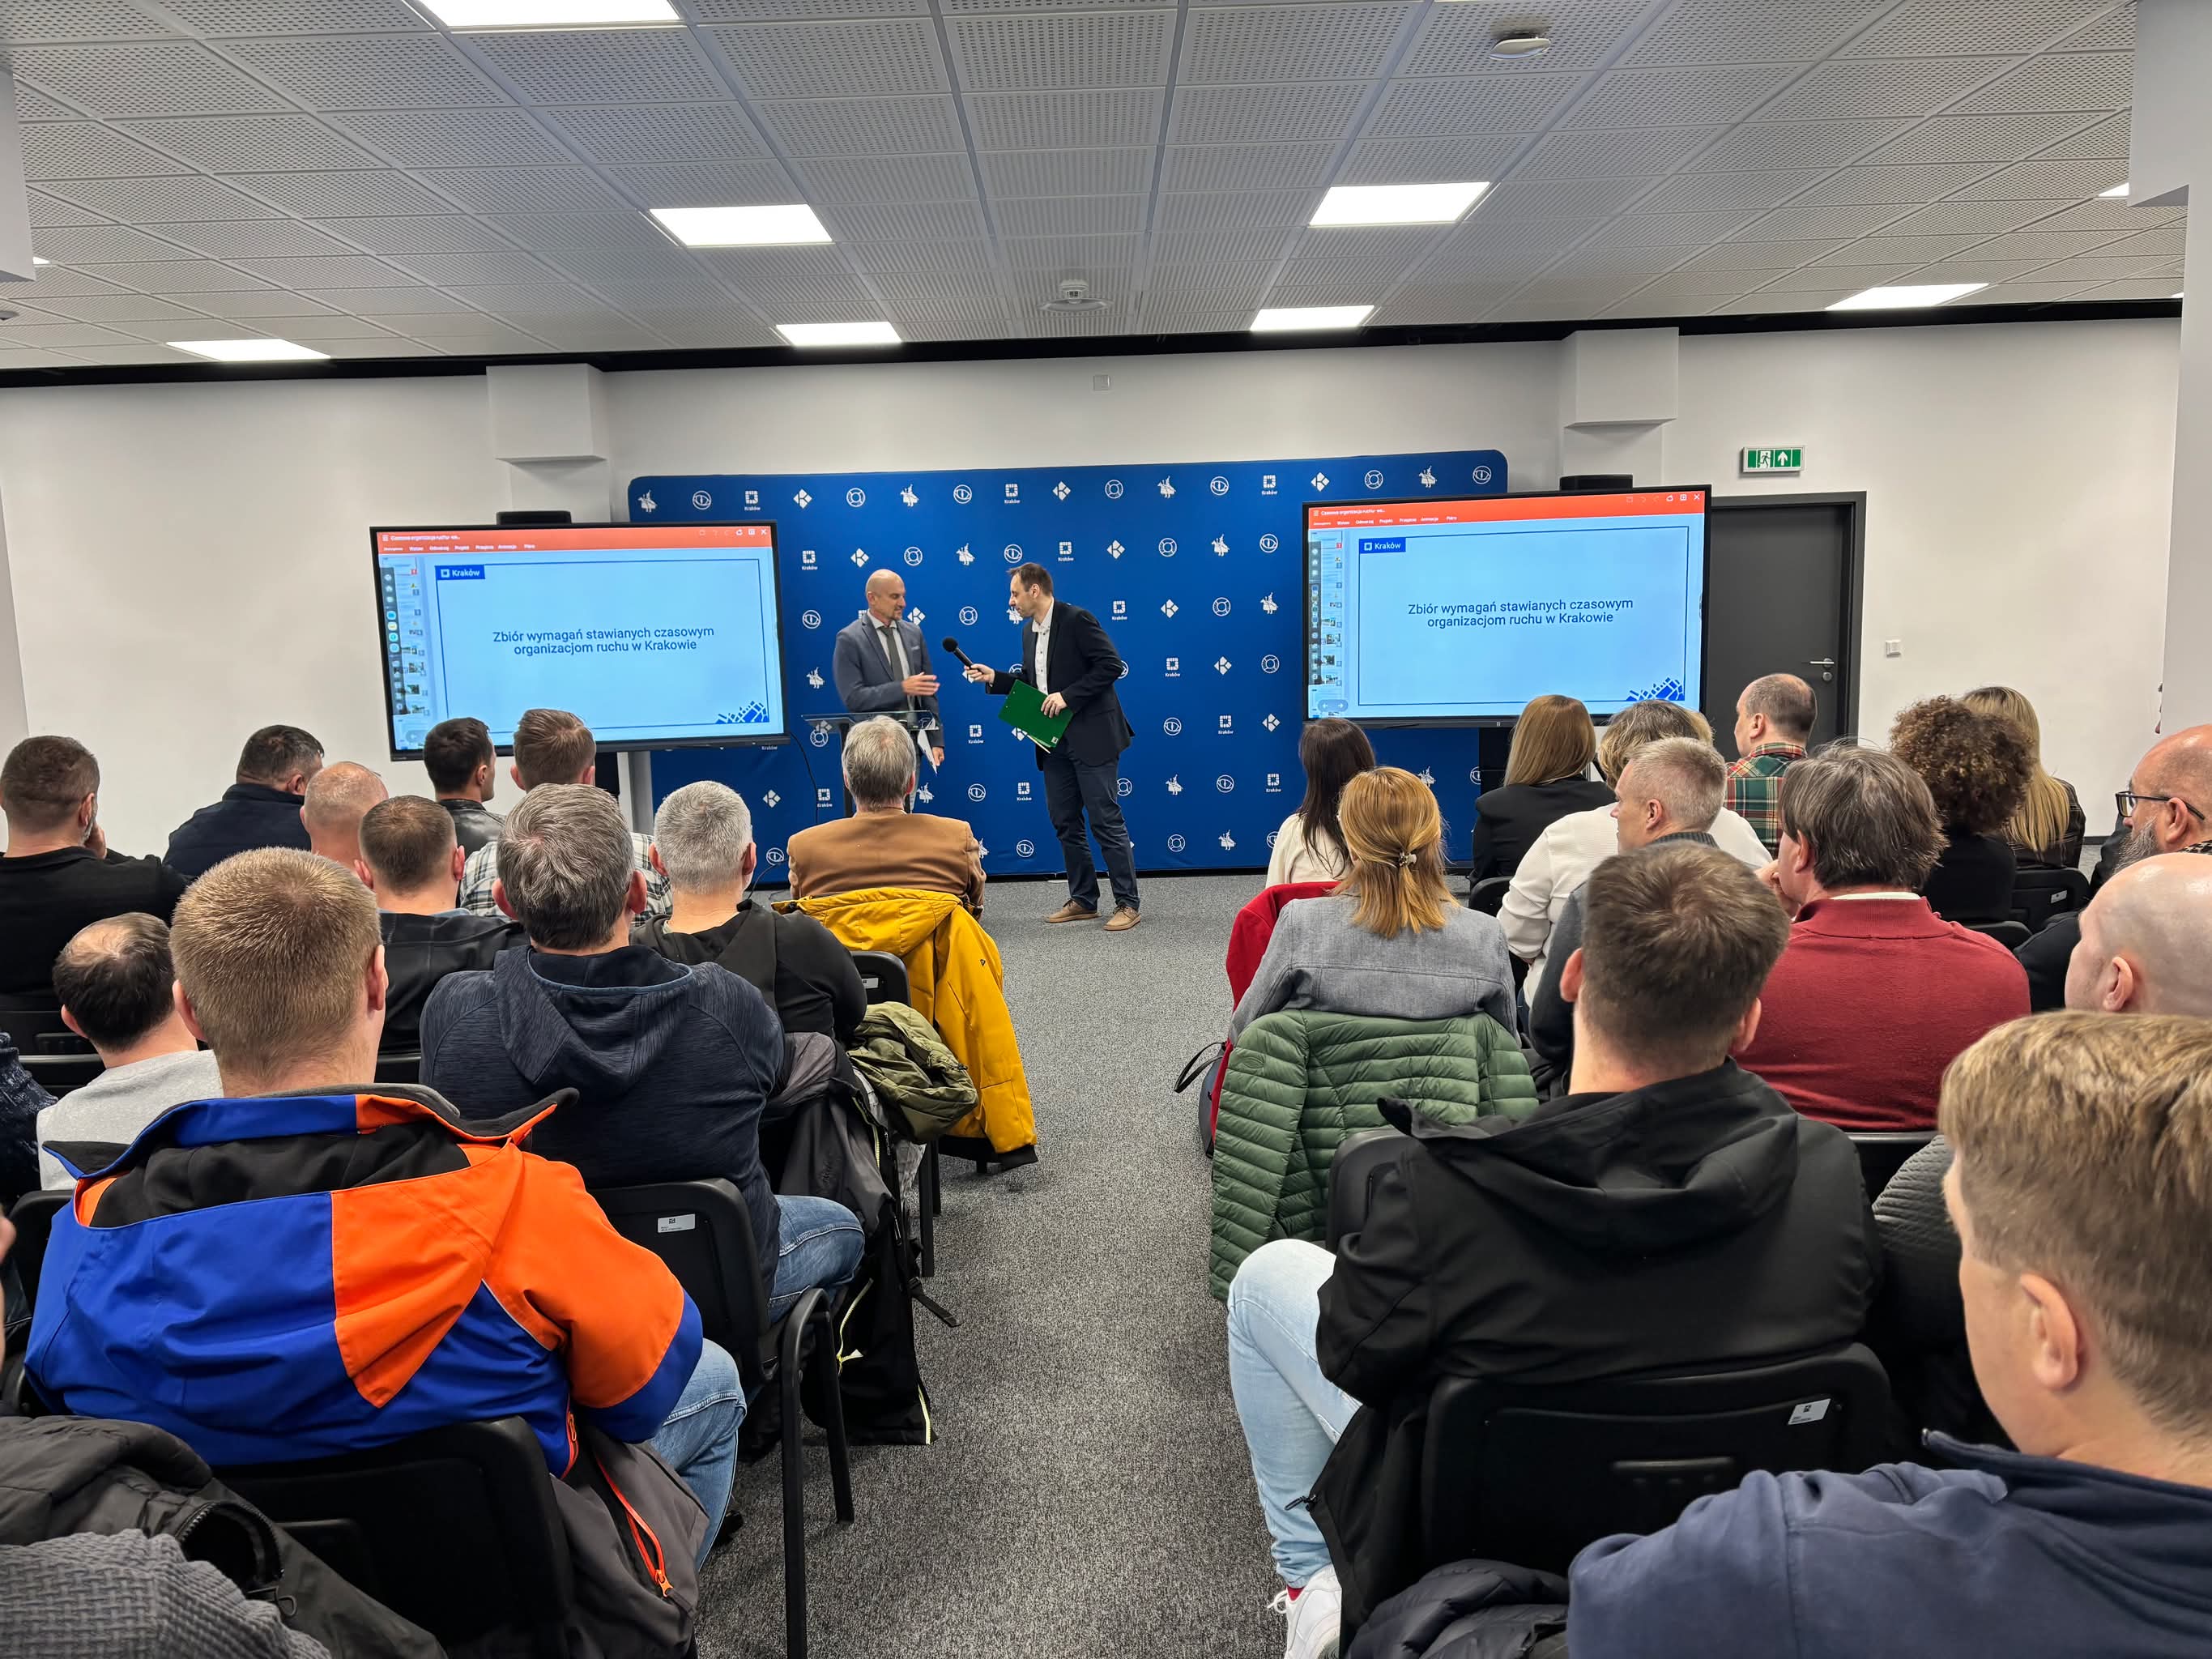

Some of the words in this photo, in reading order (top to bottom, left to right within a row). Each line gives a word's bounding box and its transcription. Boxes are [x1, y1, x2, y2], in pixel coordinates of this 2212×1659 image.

[452, 568, 479, 577] Kraków
[1408, 603, 1438, 614] Zbiór
[1441, 601, 1497, 616] wymagań
[1500, 599, 1566, 614] stawianych
[1570, 599, 1634, 611] czasowym
[1427, 616, 1506, 629] organizacjom
[1510, 613, 1542, 625] ruchu
[1545, 616, 1556, 624] w
[1559, 612, 1613, 623] Krakowie
[492, 631, 524, 642] Zbiór
[526, 629, 583, 643] wymagań
[586, 627, 650, 642] stawianych
[654, 627, 714, 638] czasowym
[514, 642, 593, 656] organizacjom
[597, 640, 629, 652] ruchu
[632, 643, 641, 651] w
[645, 639, 697, 650] Krakowie
